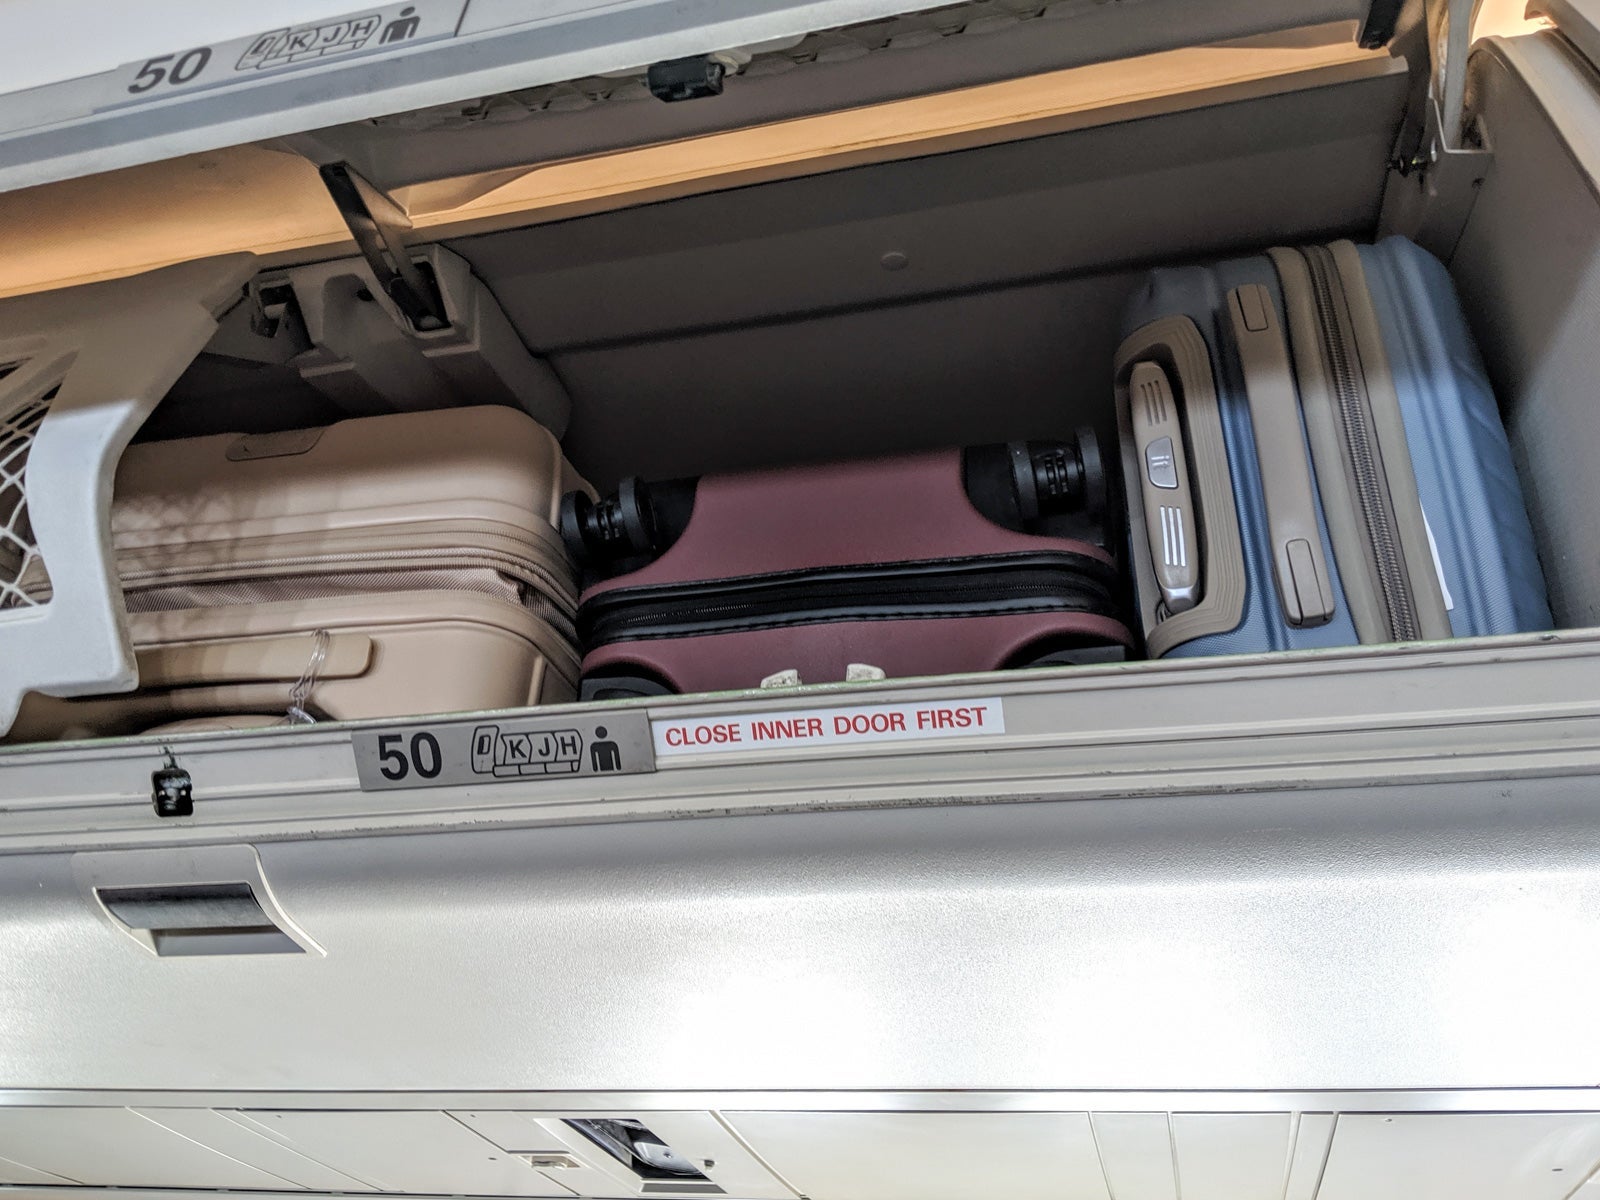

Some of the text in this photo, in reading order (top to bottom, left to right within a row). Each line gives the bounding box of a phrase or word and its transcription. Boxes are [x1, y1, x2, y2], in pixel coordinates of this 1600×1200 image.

[128, 47, 212, 94] 50
[665, 706, 987, 747] CLOSE INNER DOOR FIRST
[378, 732, 442, 781] 50
